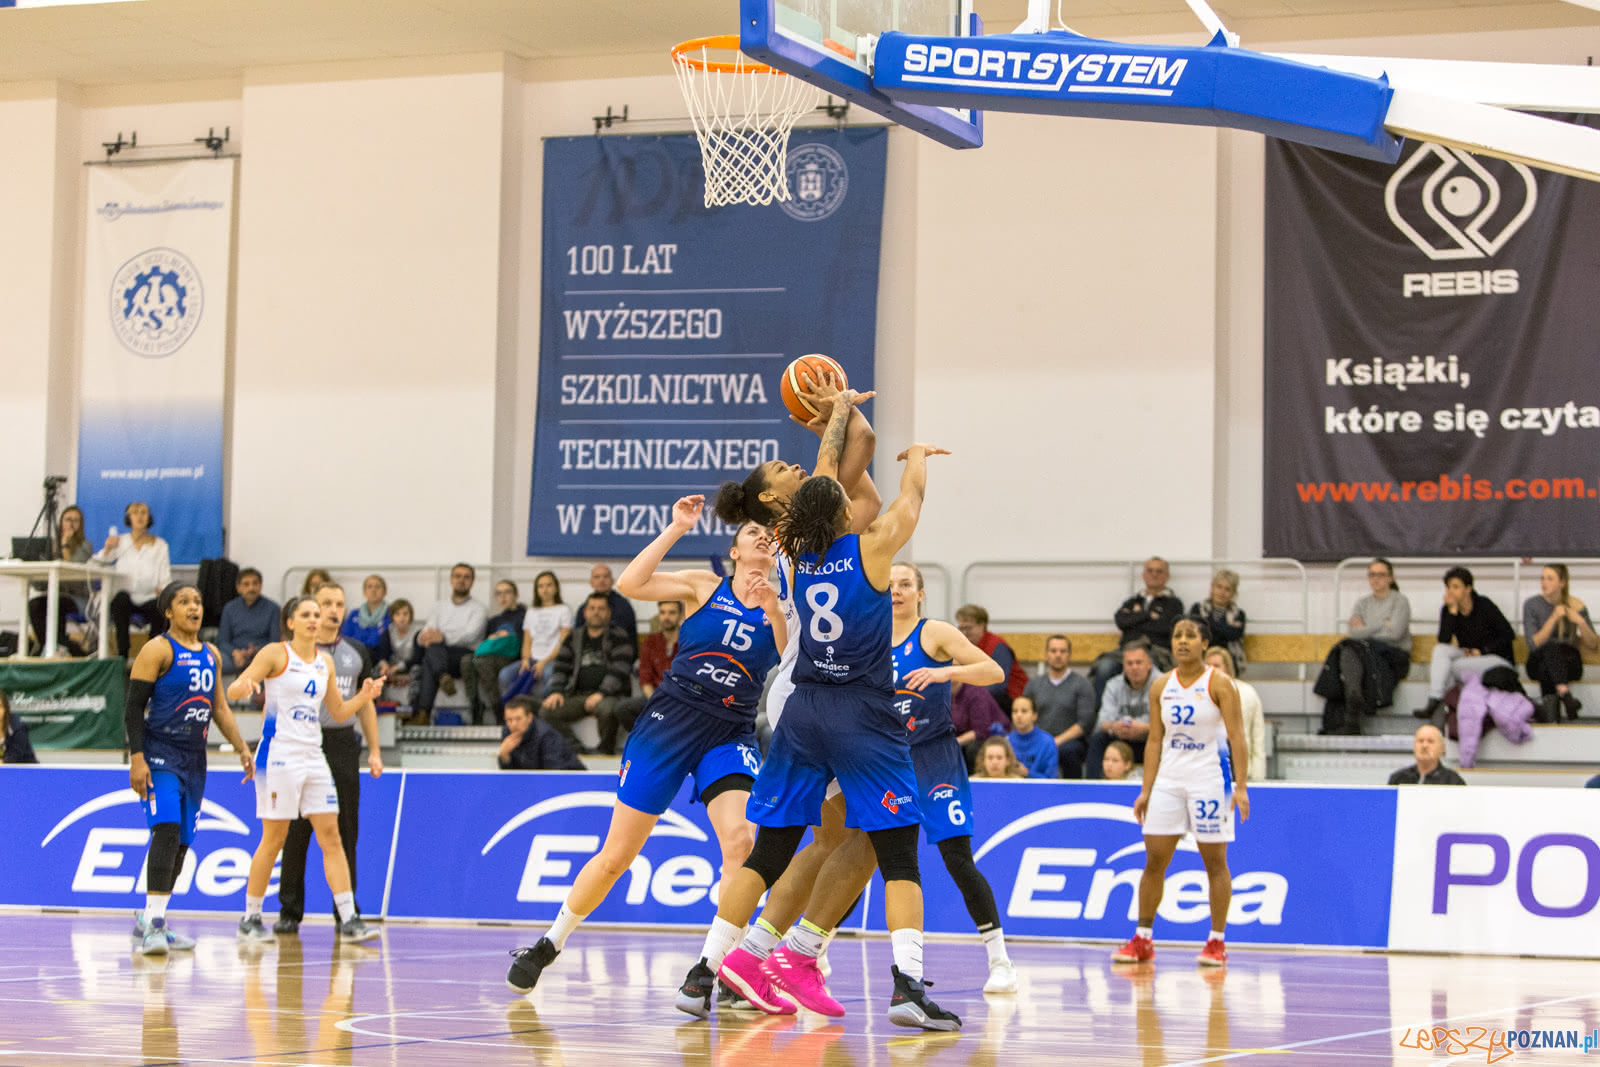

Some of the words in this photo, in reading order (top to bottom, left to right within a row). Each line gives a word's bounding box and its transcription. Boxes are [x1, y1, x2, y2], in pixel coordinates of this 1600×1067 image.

[903, 43, 1188, 88] SPORTSYSTEM
[566, 246, 614, 275] 100
[622, 244, 677, 274] LAT
[1403, 269, 1520, 297] REBIS
[563, 301, 723, 340] WYŻSZEGO
[1326, 355, 1471, 390] Książki,
[560, 374, 768, 404] SZKOLNICTWA
[1325, 405, 1422, 433] które
[1433, 404, 1489, 437] się
[1500, 401, 1600, 436] czyta
[559, 439, 779, 470] TECHNICZNEGO
[1296, 474, 1600, 502] www.rebis.com.
[556, 504, 585, 535] W
[805, 582, 843, 642] 8
[721, 619, 756, 651] 15
[189, 667, 214, 692] 30
[304, 679, 317, 699] 4
[696, 662, 741, 687] PGE
[1170, 705, 1195, 726] 32
[1171, 737, 1205, 751] Enea
[933, 789, 954, 801] PGE
[947, 800, 966, 826] 6
[1195, 800, 1220, 821] 32
[1007, 847, 1289, 925] Enea
[1432, 833, 1600, 918] PO
